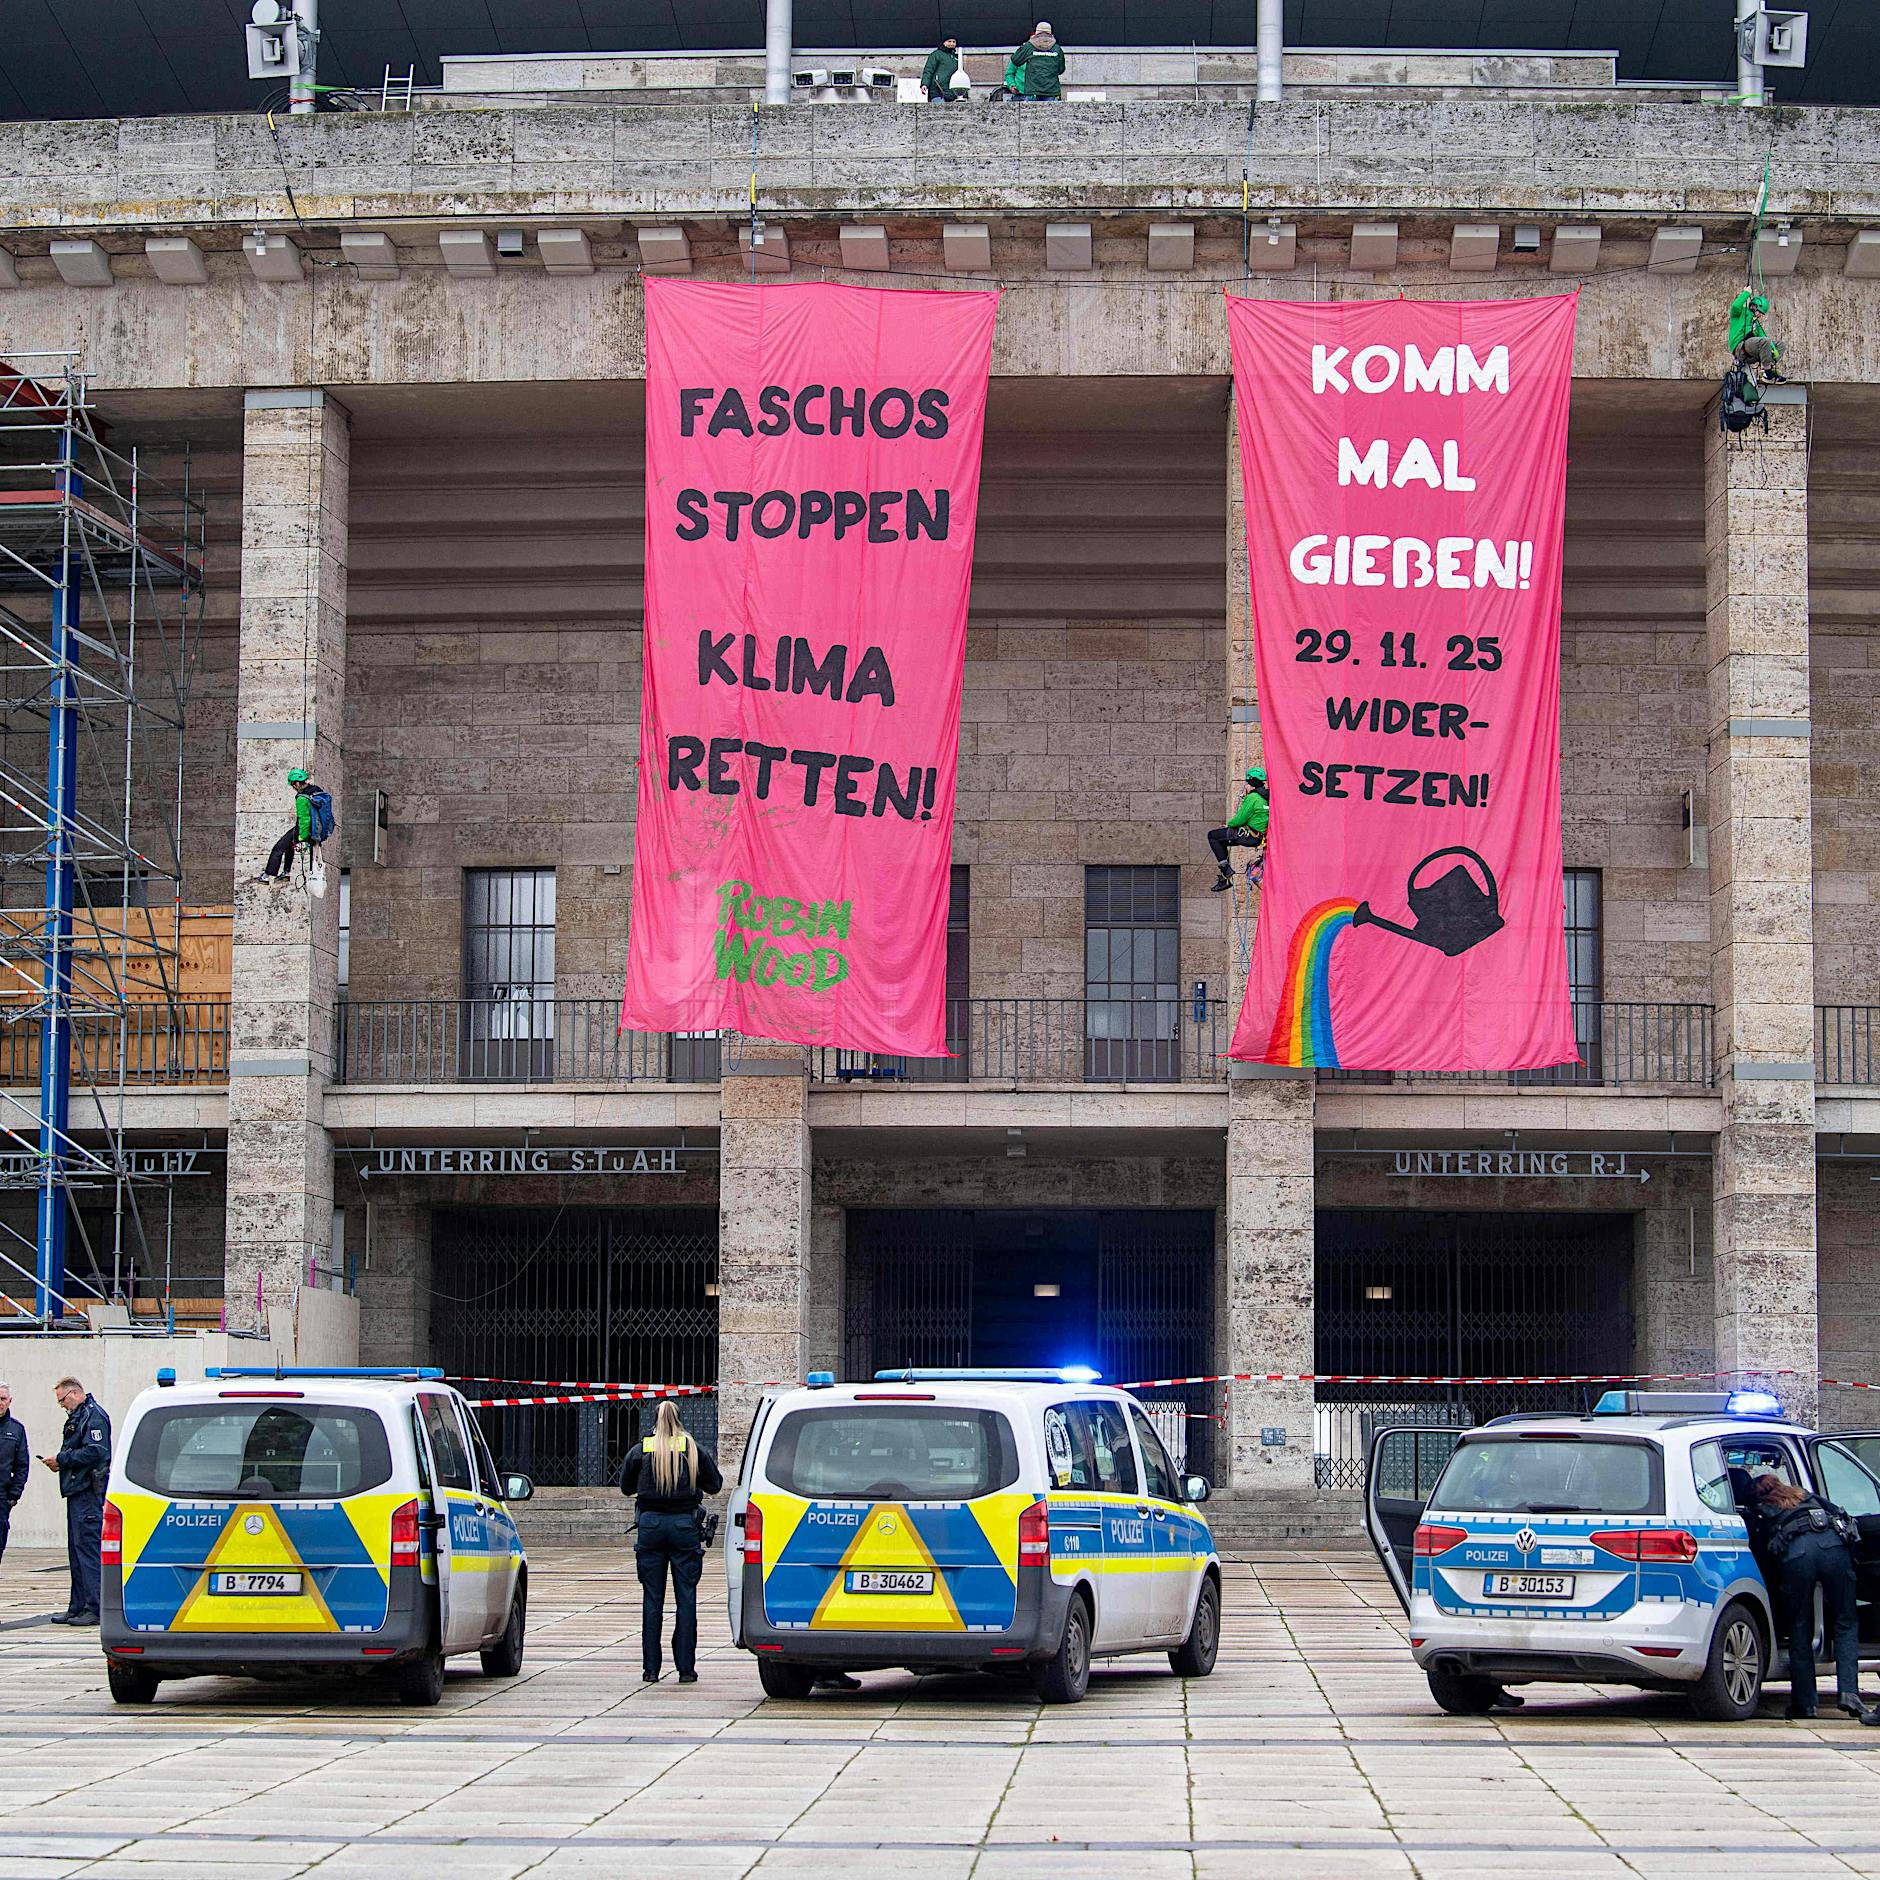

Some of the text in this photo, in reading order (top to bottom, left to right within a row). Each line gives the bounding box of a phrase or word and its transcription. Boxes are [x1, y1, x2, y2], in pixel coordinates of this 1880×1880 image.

[1311, 343, 1510, 396] KOMM
[680, 384, 950, 440] FASCHOS
[1338, 436, 1476, 492] MAL
[675, 487, 950, 543] STOPPEN
[1289, 534, 1533, 590] GIEßEN!
[698, 629, 896, 707] KLIMA
[1295, 628, 1503, 672] 29. 11. 25
[1326, 696, 1490, 740] WIDER-
[667, 735, 937, 821] RETTEN!
[1299, 760, 1489, 809] SETZEN!
[716, 879, 852, 940] ROBIN
[714, 928, 849, 992] WOOD
[379, 1150, 549, 1172] UNTERRING
[1394, 1152, 1626, 1175] UNTERRING R-J
[166, 1515, 222, 1527] POLIZEI
[453, 1515, 480, 1543] POLIZEI
[808, 1512, 859, 1526] POLIZEI
[1111, 1519, 1145, 1544] POLIZEI
[1465, 1550, 1509, 1562] POLIZEI
[226, 1575, 285, 1590] B 7794
[860, 1574, 924, 1589] B 30462
[1499, 1577, 1565, 1593] B 30153
